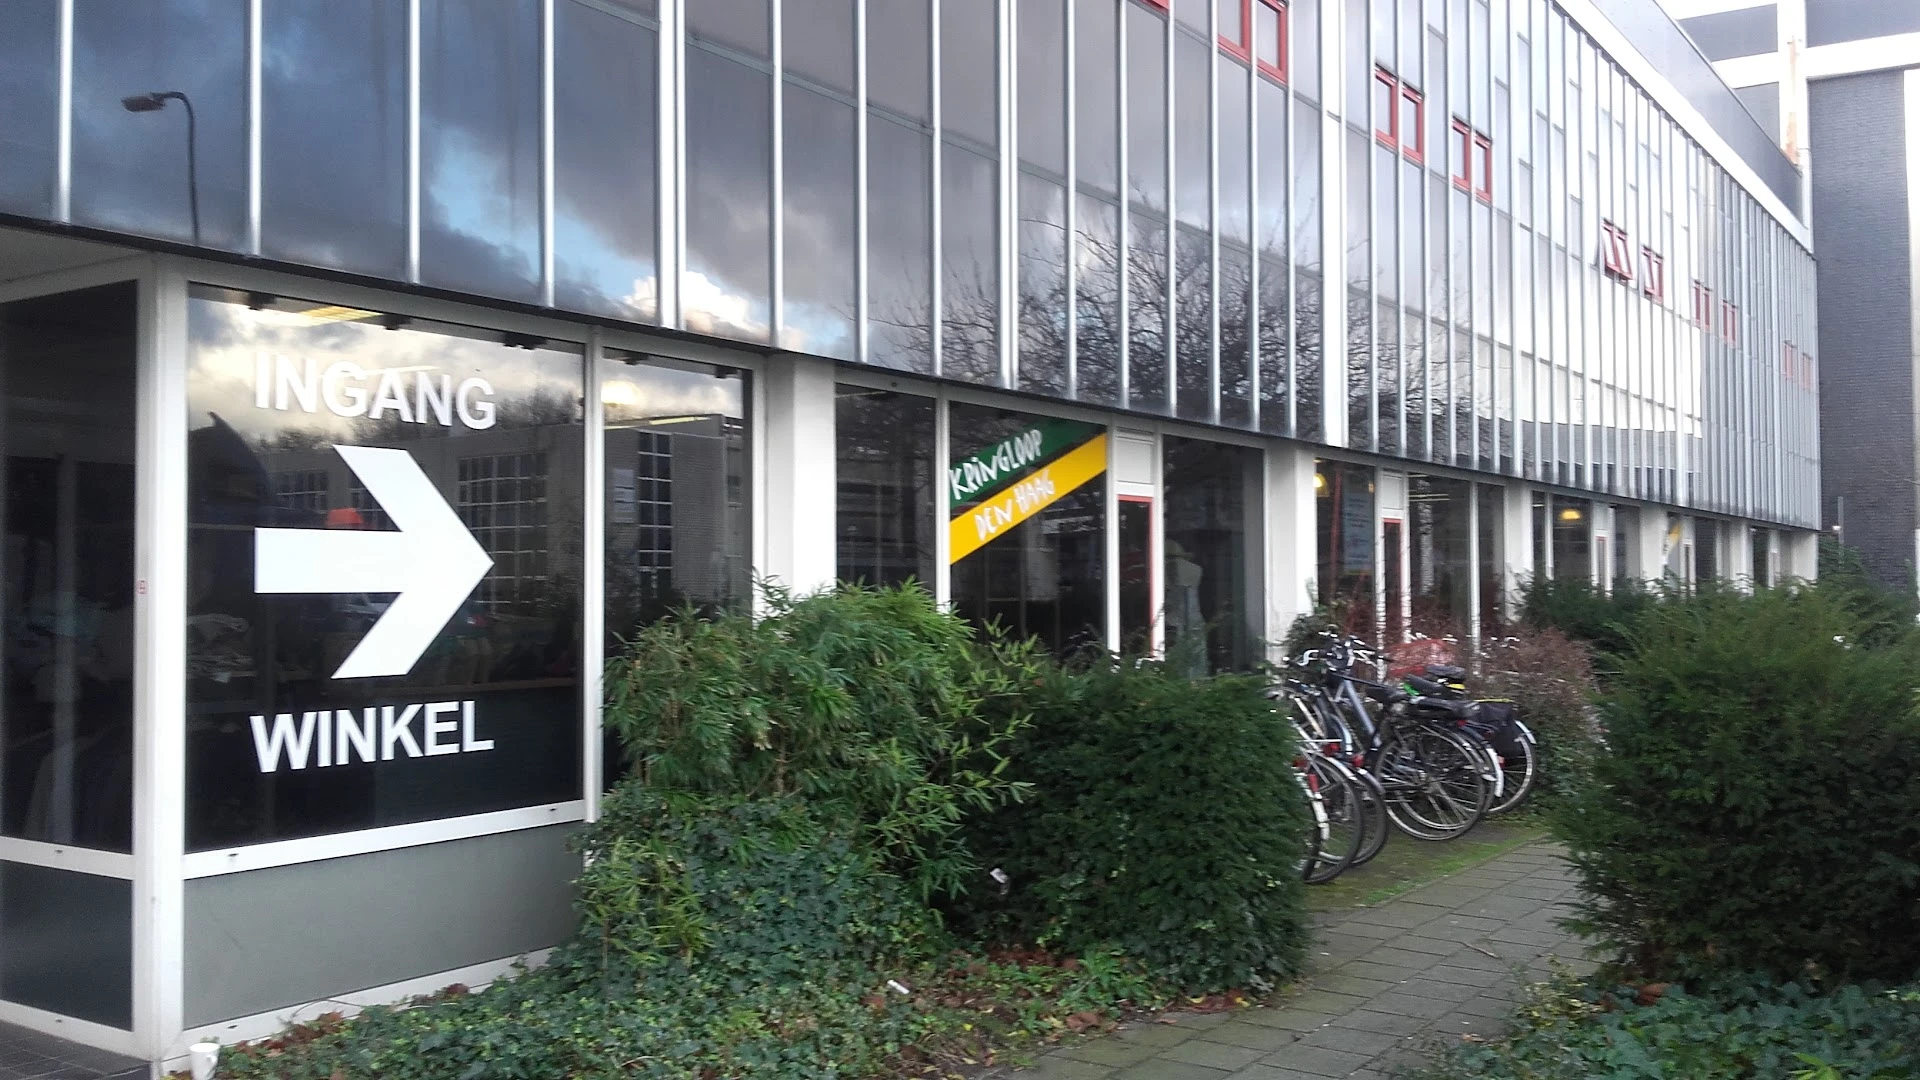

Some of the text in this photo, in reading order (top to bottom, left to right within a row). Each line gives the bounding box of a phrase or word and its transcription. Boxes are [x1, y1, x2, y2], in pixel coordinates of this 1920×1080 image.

[255, 353, 497, 430] INGANG
[974, 470, 1055, 541] DEN HAAG
[250, 700, 495, 773] WINKEL
